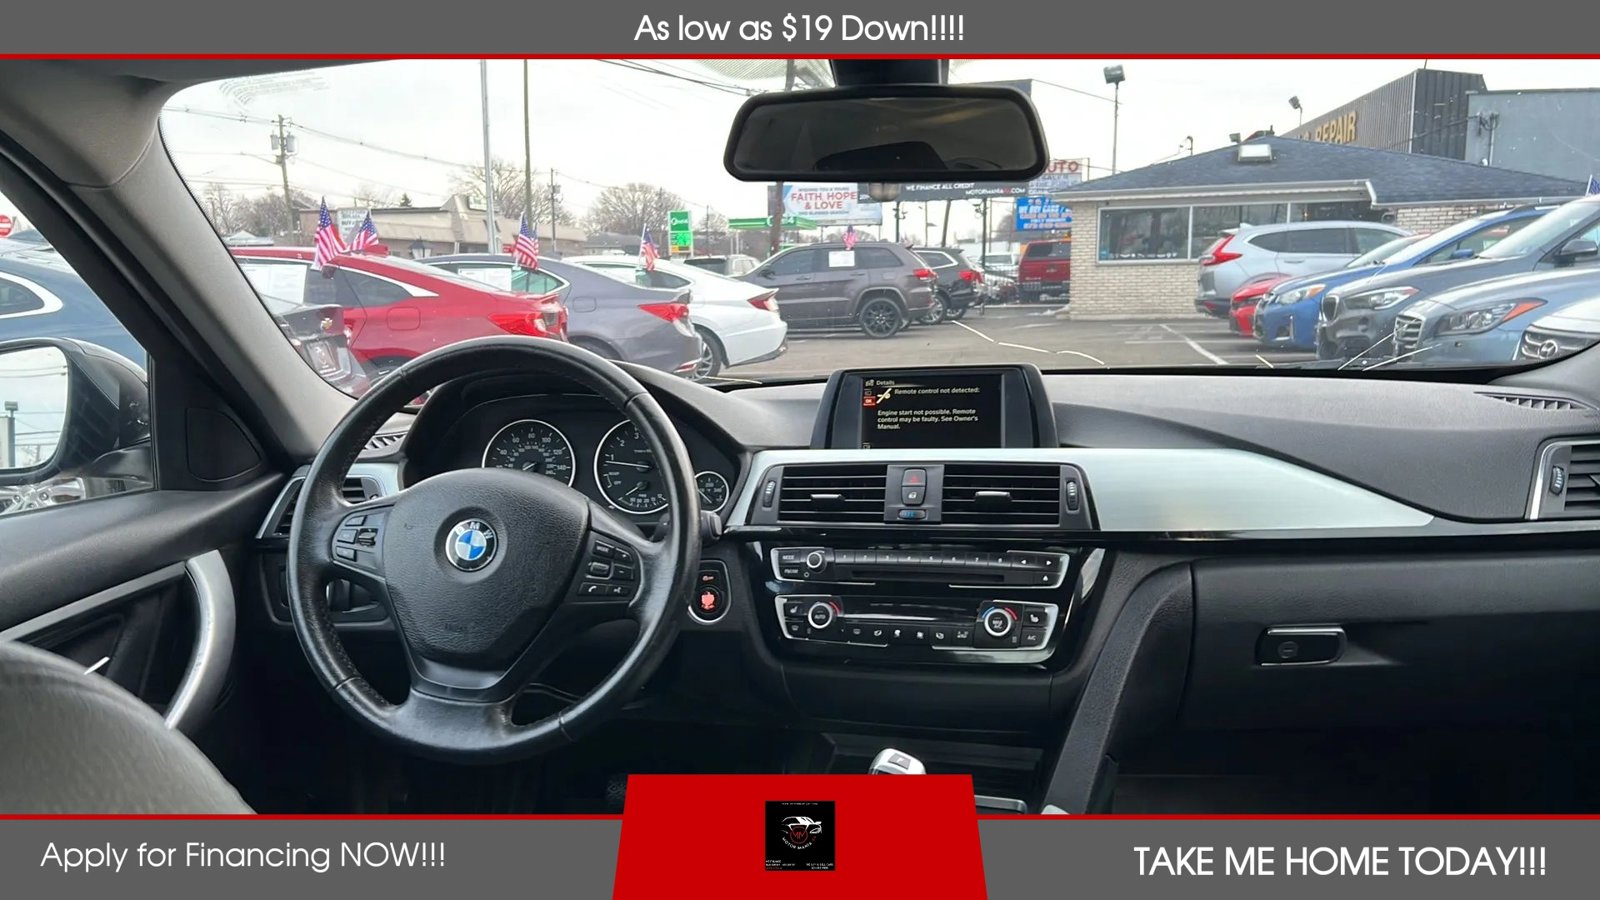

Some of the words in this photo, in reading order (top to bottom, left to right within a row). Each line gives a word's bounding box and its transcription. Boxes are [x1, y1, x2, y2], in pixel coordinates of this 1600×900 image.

[1315, 111, 1357, 144] REPAIR
[827, 191, 857, 200] HOPE
[814, 201, 843, 210] LOVE
[921, 415, 940, 423] faulty.
